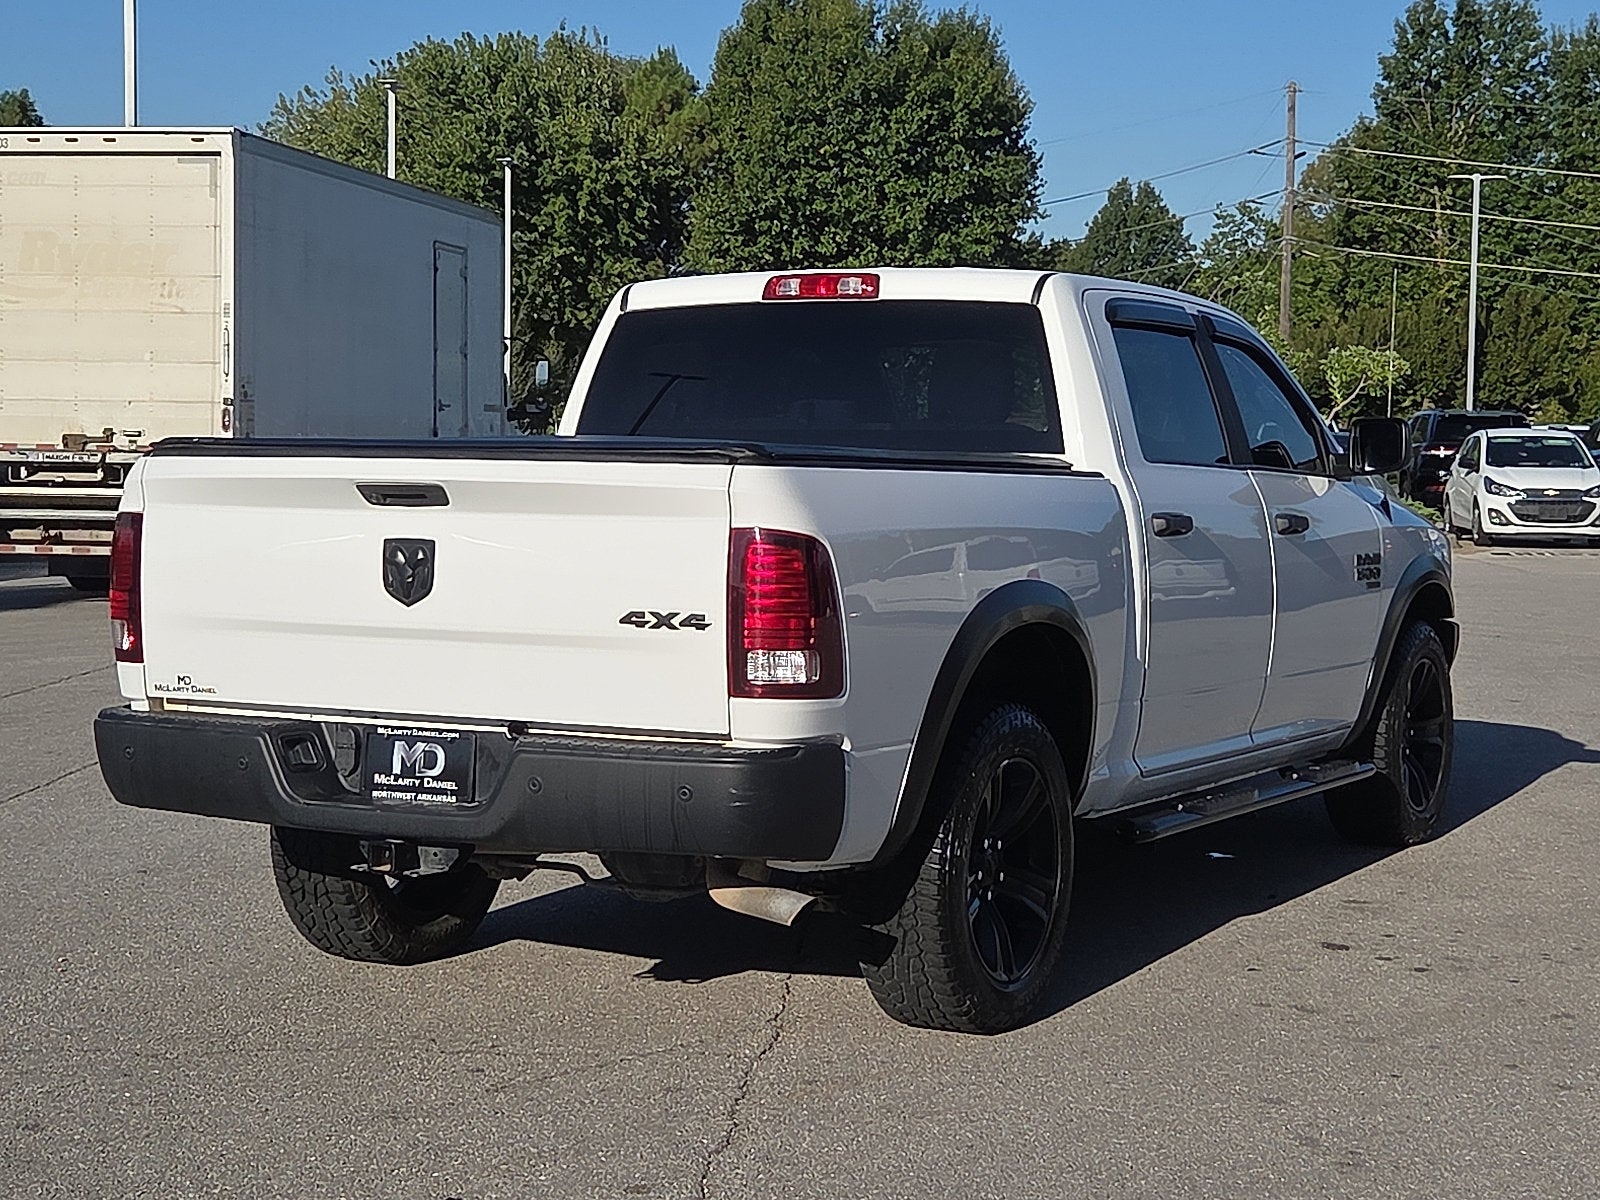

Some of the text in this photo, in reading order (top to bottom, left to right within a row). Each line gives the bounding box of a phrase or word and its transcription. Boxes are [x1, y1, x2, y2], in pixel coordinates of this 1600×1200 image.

[392, 740, 446, 777] MD
[372, 791, 457, 803] NORTHWEST ARKANSAS
